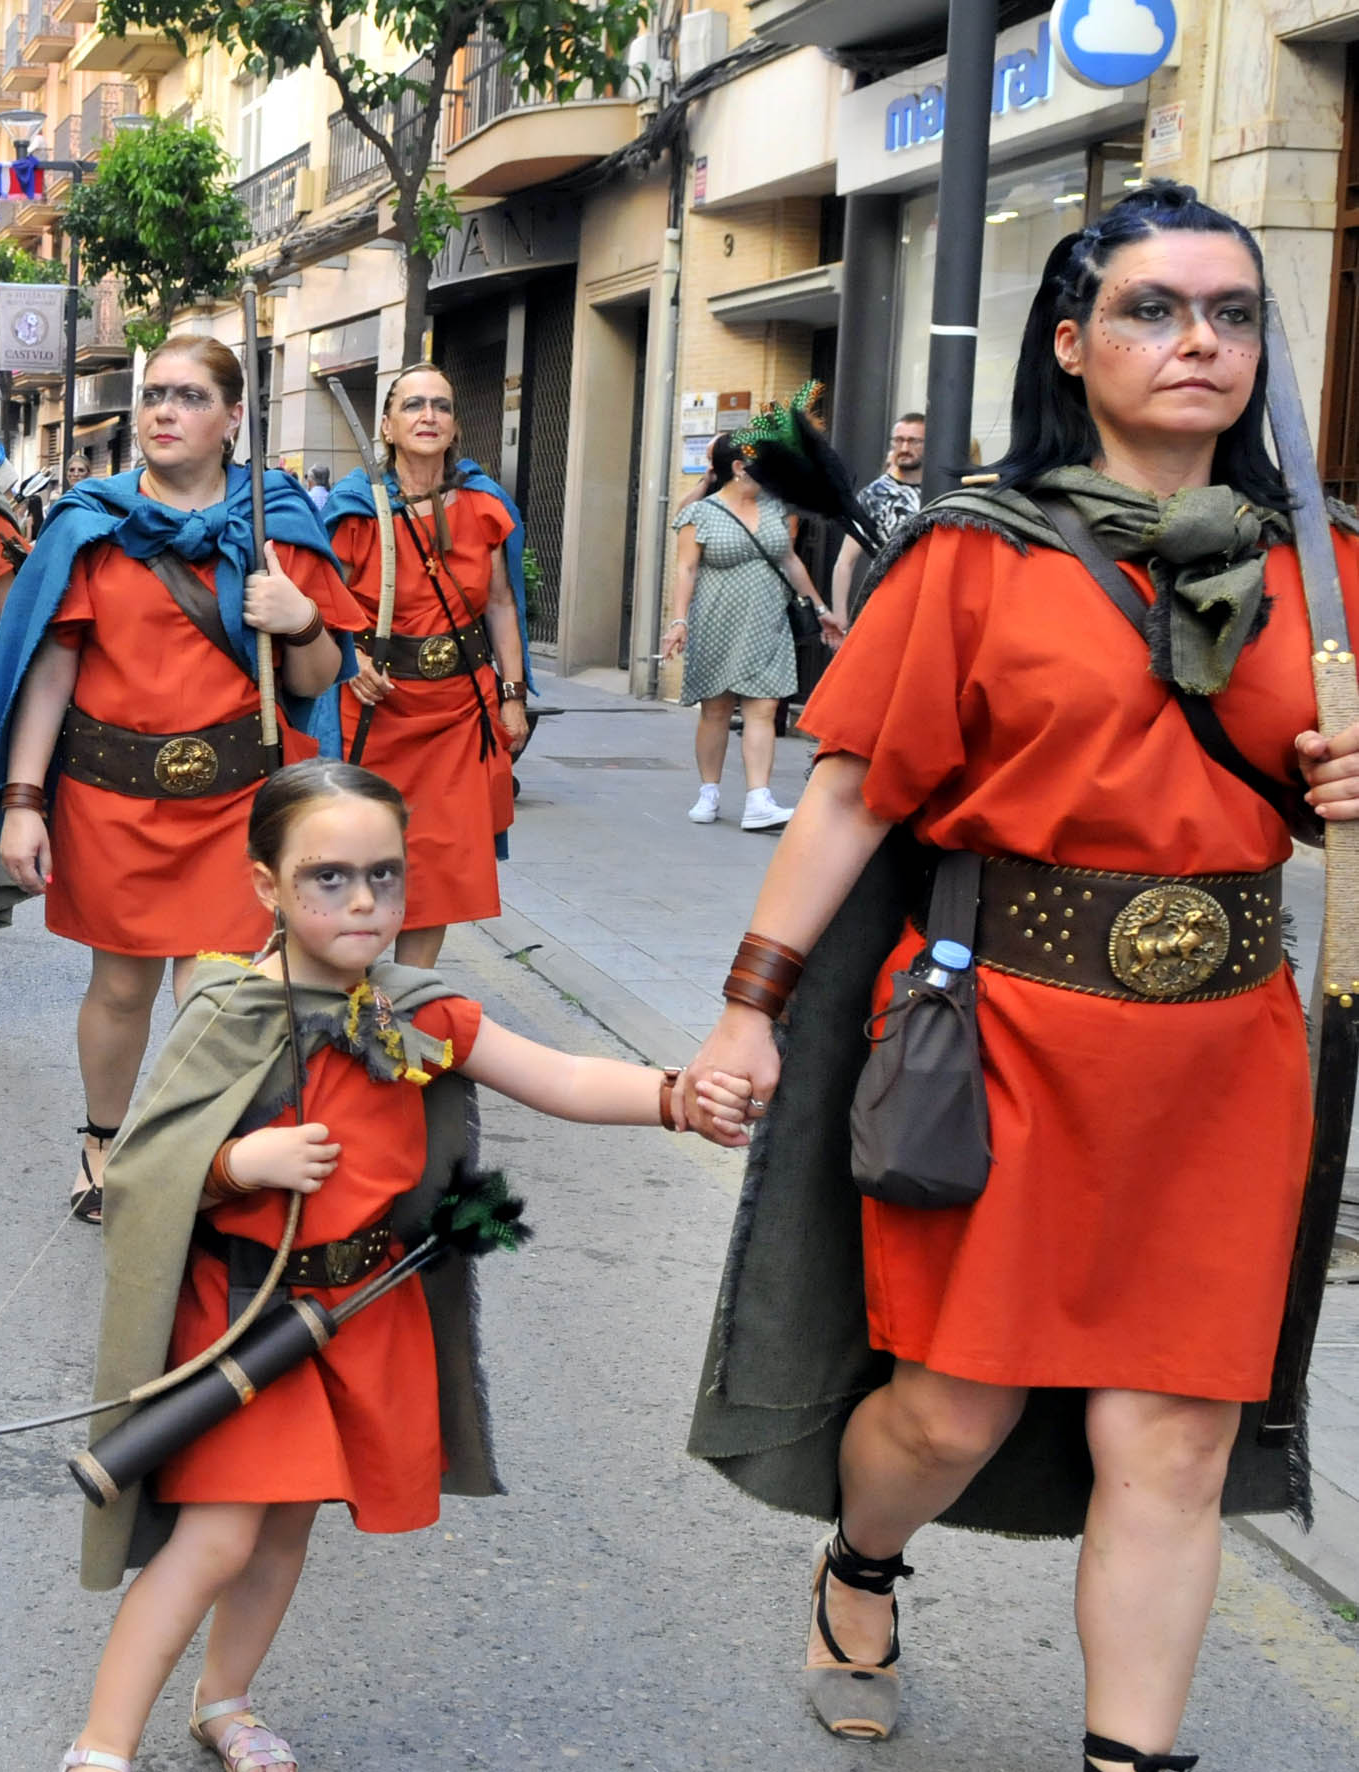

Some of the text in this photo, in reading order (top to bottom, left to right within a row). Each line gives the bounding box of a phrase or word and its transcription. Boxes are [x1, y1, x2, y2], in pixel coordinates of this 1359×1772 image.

[885, 21, 1054, 152] maral
[723, 233, 734, 258] 9
[5, 349, 54, 361] CASTVLO
